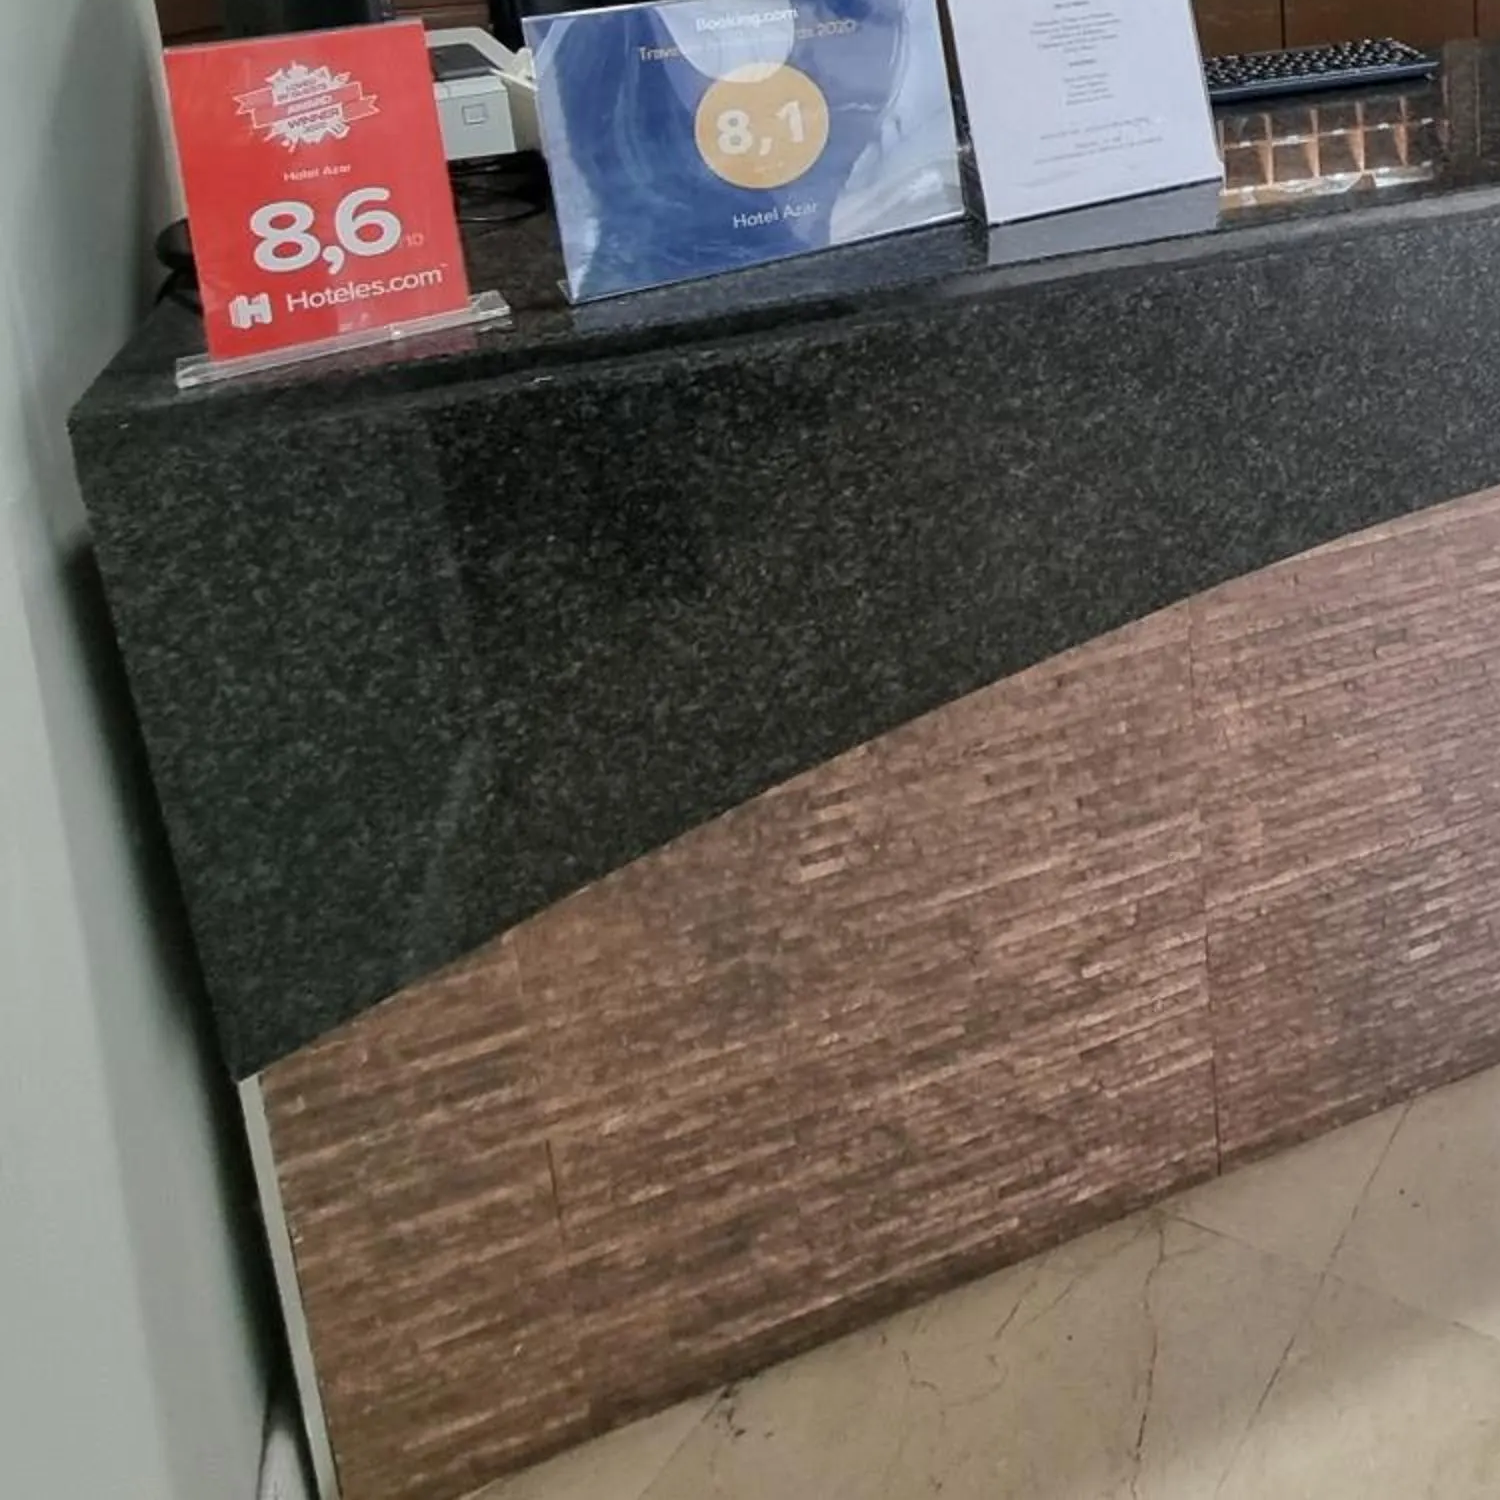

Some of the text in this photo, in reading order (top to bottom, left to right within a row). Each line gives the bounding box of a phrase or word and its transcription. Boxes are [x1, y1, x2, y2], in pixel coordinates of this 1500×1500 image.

[696, 7, 798, 32] Booking.com
[717, 100, 804, 155] 8,1
[284, 163, 351, 182] Hotel Azar
[250, 187, 401, 275] 8,6
[733, 206, 779, 229] Hotel
[286, 269, 442, 312] Hoteles.com
